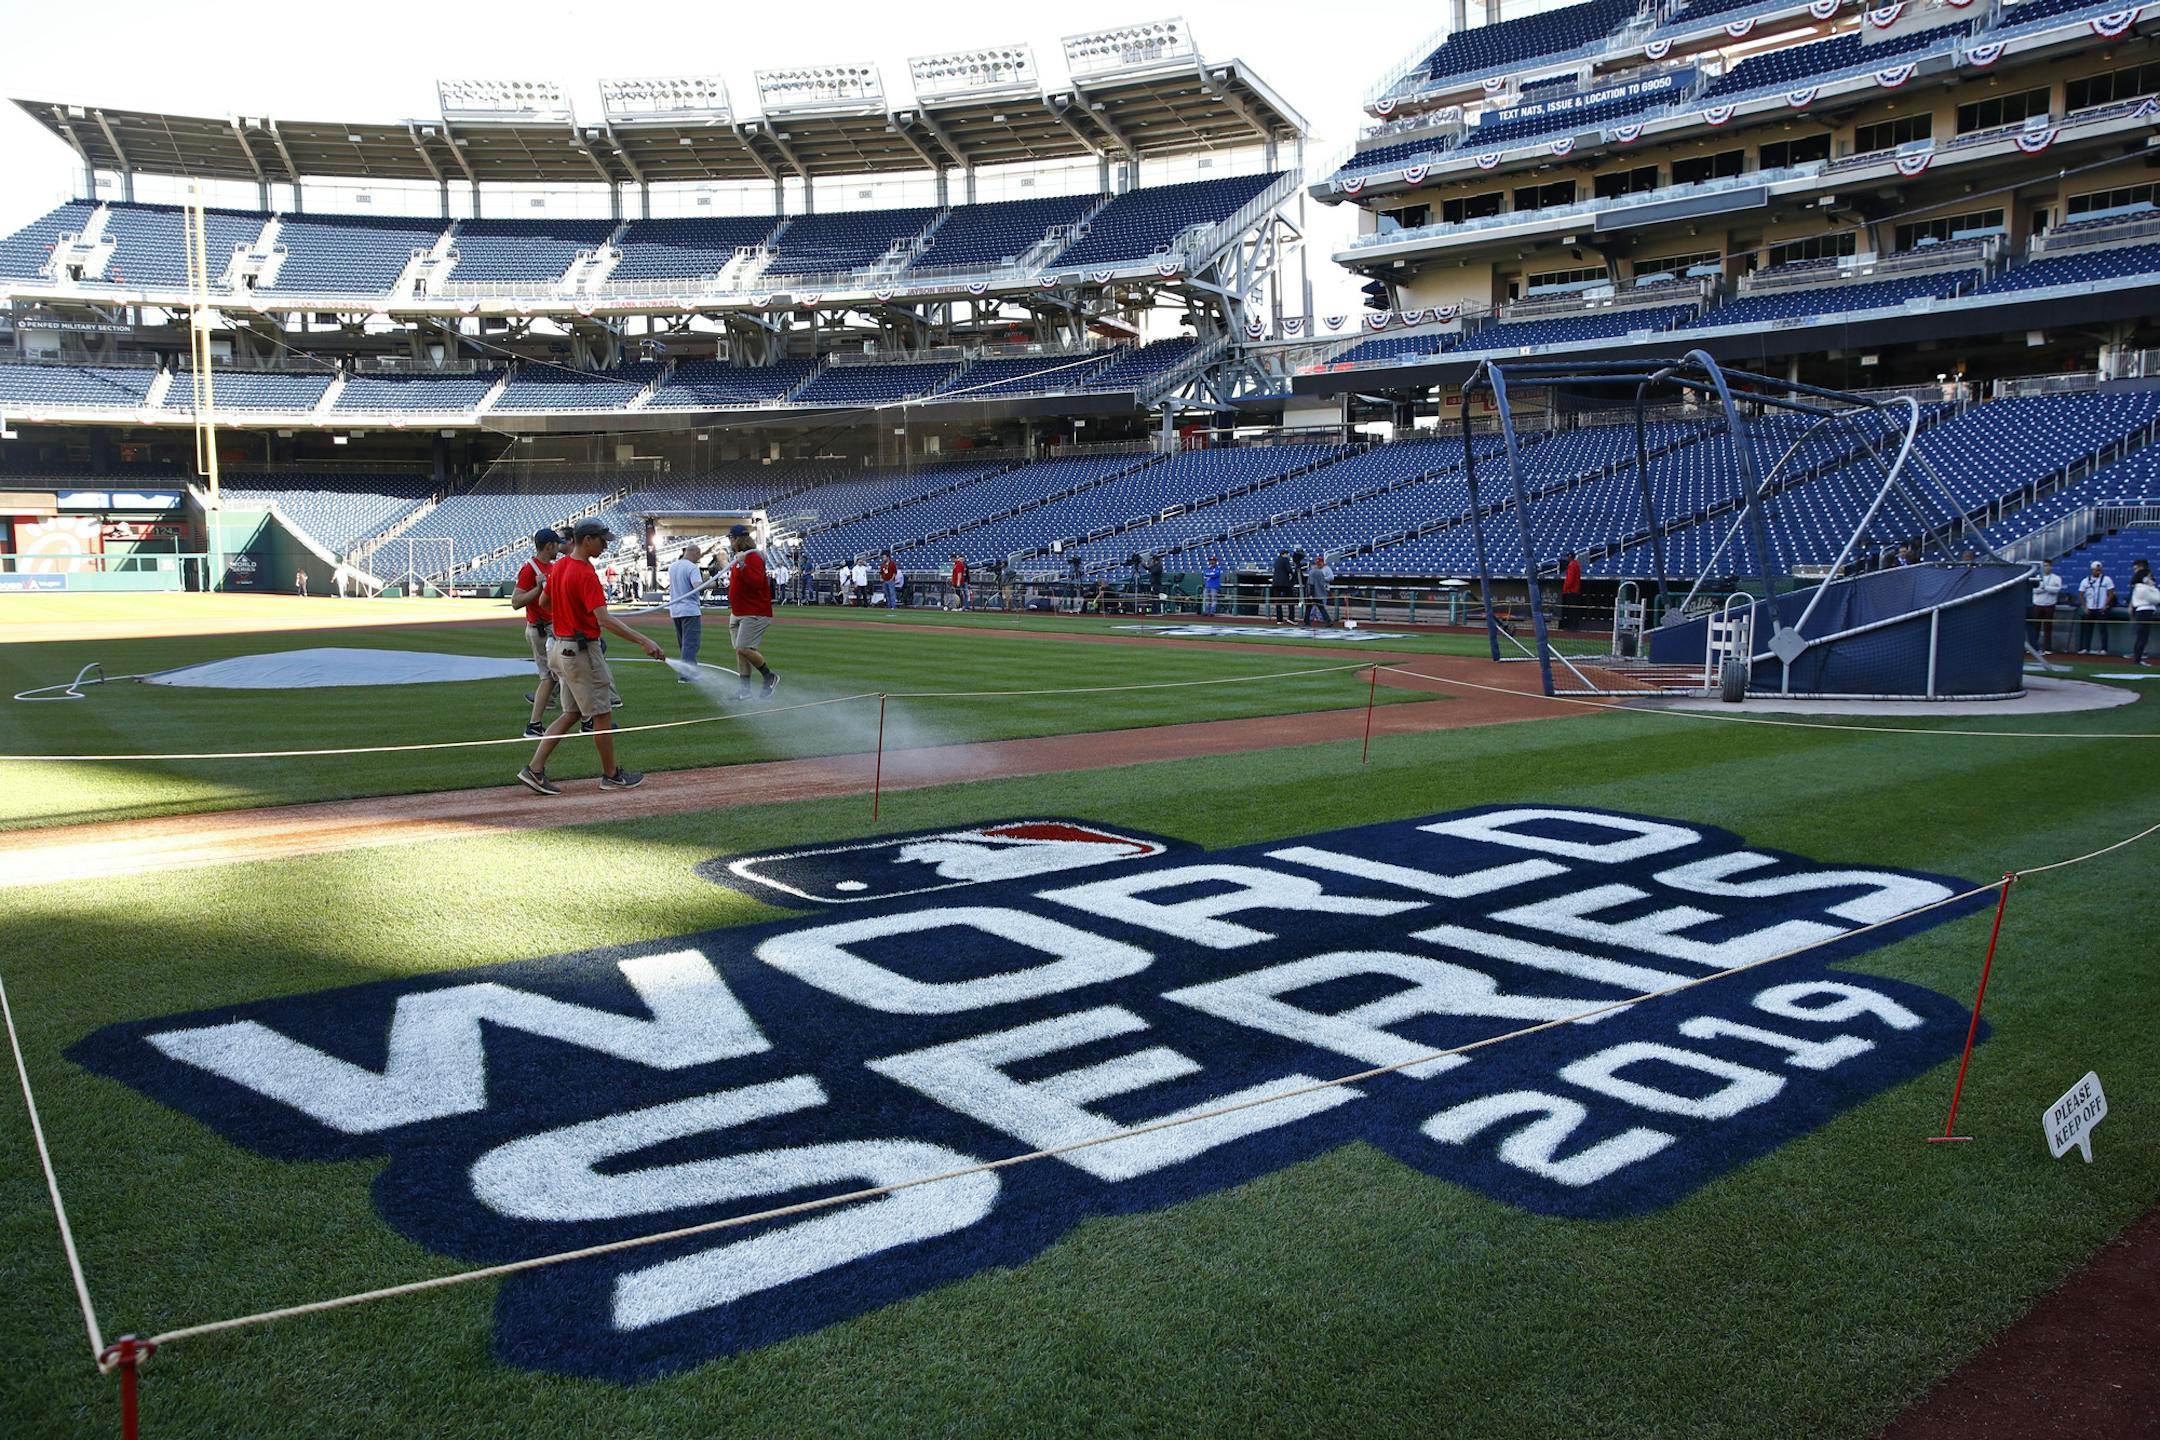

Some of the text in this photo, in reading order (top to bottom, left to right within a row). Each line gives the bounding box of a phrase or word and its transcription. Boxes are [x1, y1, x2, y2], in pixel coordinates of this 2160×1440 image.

[1498, 76, 1672, 121] TEXT NATS, ISSUE & LOCATION TO 69050
[639, 300, 675, 308] HOWARD
[906, 285, 965, 296] JAYSON WERTH
[27, 321, 60, 329] PENFED
[61, 323, 97, 331] MILITARY
[144, 808, 1705, 1135] WORLD
[469, 851, 1955, 1332] SERIES
[1419, 979, 1927, 1189] 2019
[2054, 1081, 2092, 1126] PLEASE
[2054, 1095, 2102, 1150] KEEP OFF
